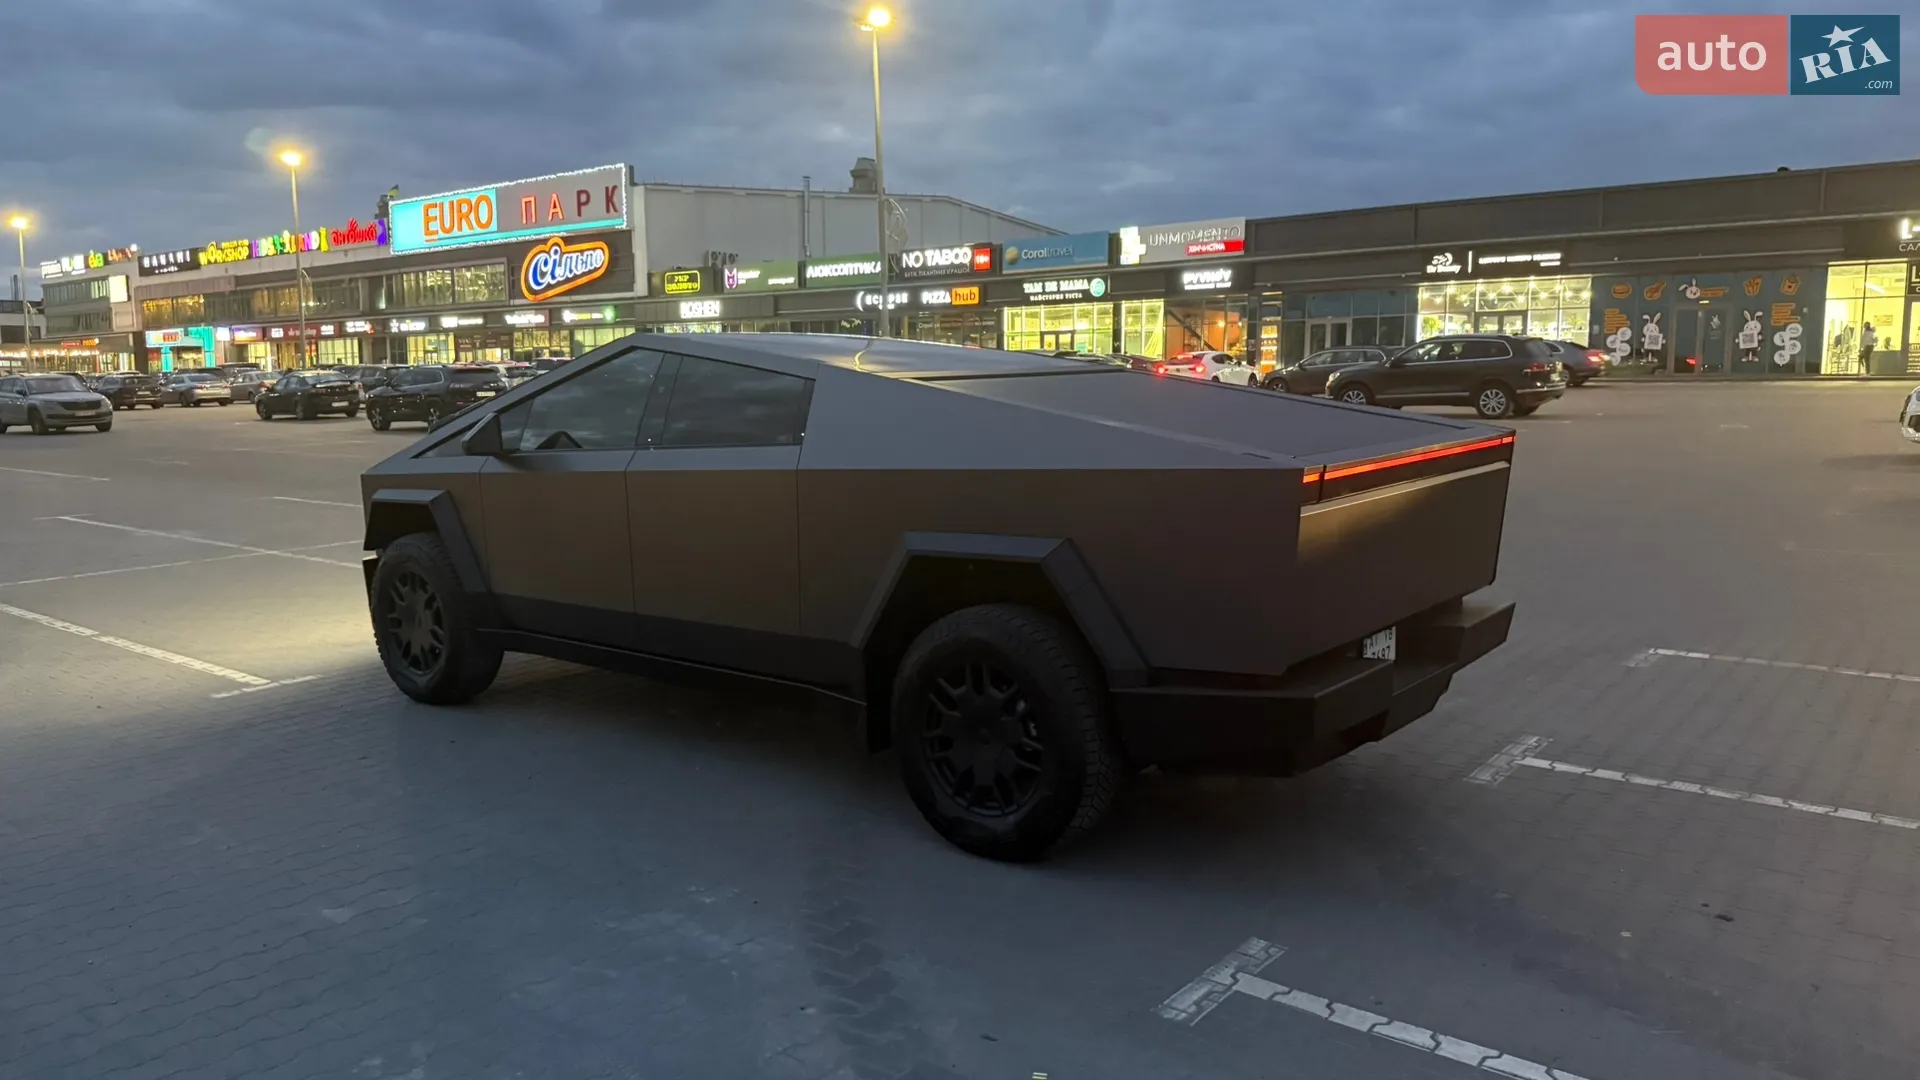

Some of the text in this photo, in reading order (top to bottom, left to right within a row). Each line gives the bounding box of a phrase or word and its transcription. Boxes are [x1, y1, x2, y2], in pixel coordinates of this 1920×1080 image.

[520, 184, 620, 225] ПАРК
[423, 194, 493, 239] EURO
[1149, 226, 1241, 247] UNMOMENTO
[199, 241, 249, 265] WORKSHOP
[902, 247, 972, 268] NO TABOO
[529, 242, 605, 290] Сільпо
[921, 288, 976, 304] PIZZA hub
[680, 300, 720, 319] ROSHEN
